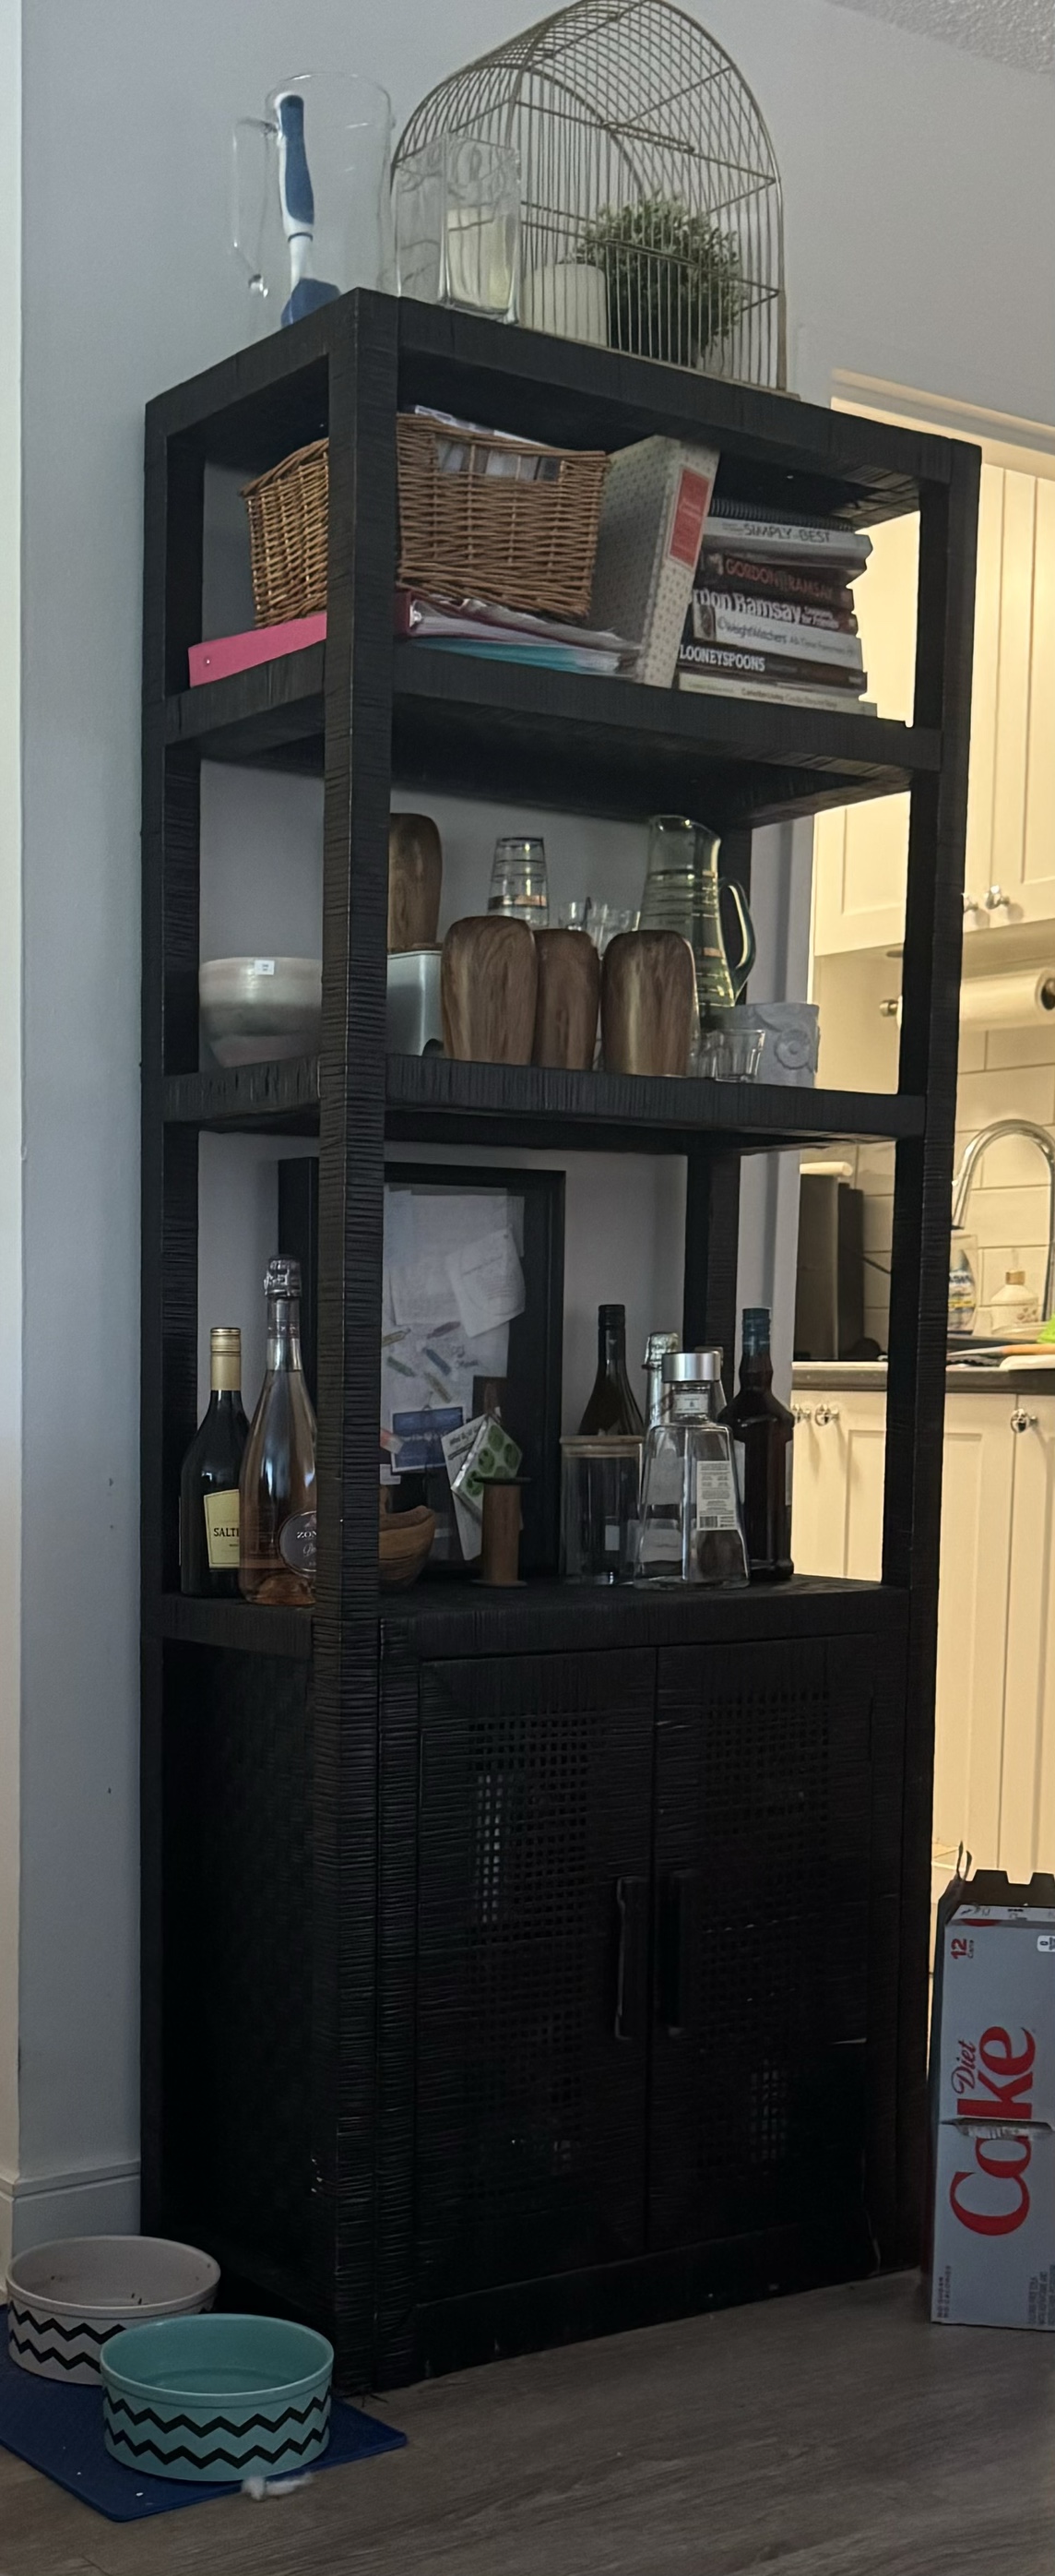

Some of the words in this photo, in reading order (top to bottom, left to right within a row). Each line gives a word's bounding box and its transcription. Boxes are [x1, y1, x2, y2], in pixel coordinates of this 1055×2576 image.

[743, 523, 792, 540] SIMPLY
[799, 529, 831, 543] BEST
[725, 558, 781, 588] GORDON
[693, 588, 731, 611] rdon
[732, 591, 801, 625] Ramsay
[680, 644, 766, 673] LOONEYSPOONS
[296, 1530, 317, 1539] ZON
[950, 1938, 967, 1960] 12
[951, 2038, 978, 2095] Diet
[949, 2025, 1037, 2236] Coke
